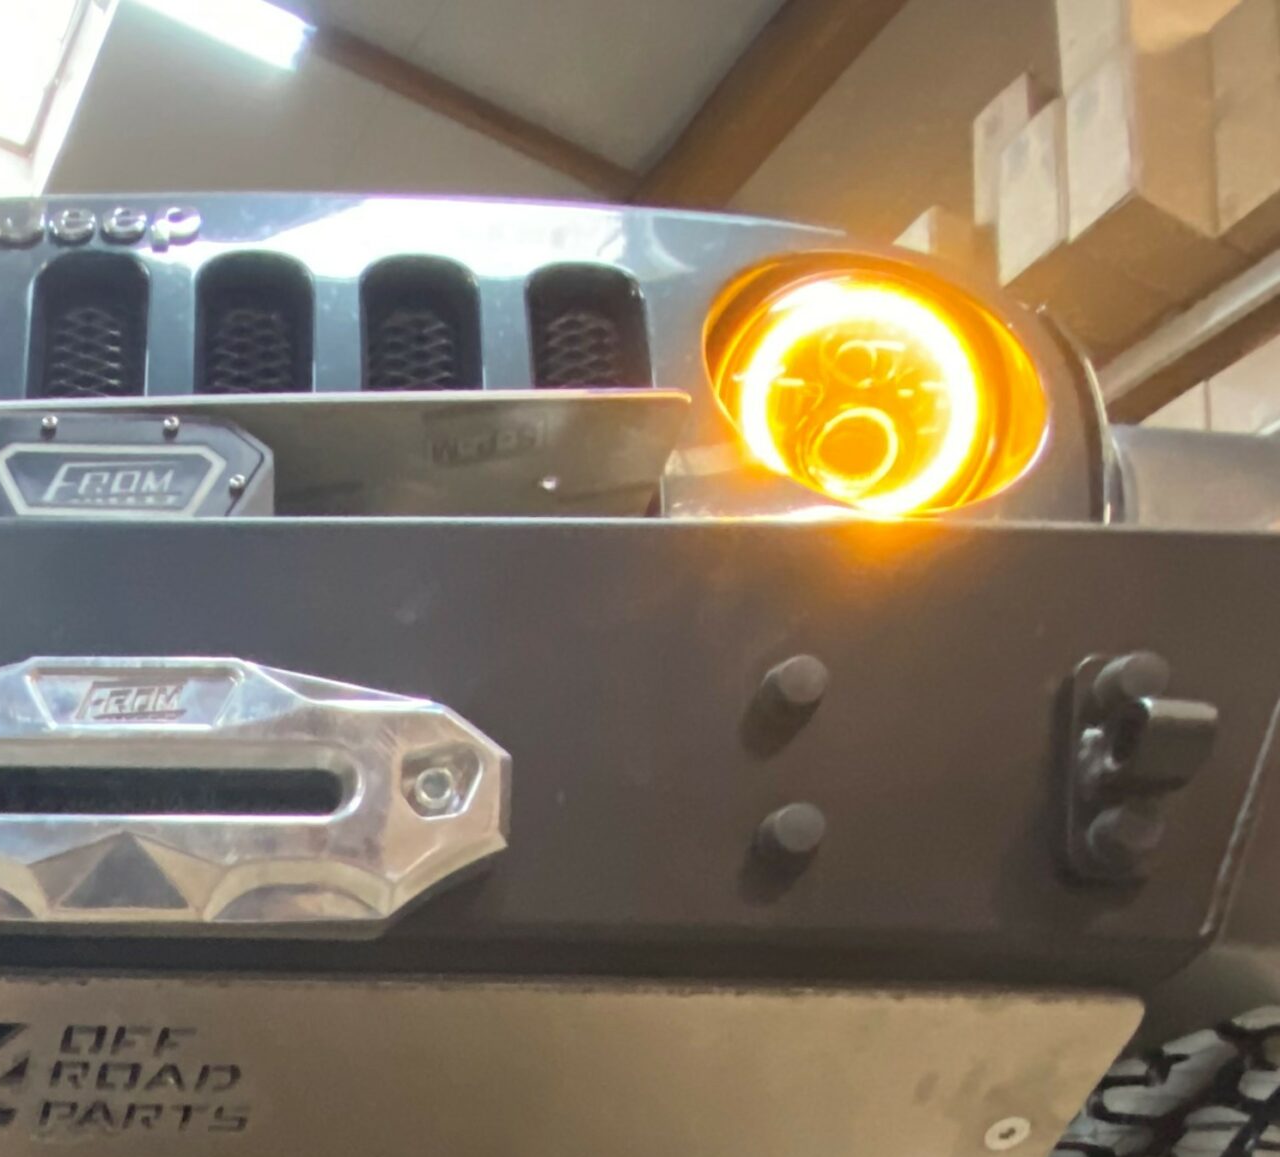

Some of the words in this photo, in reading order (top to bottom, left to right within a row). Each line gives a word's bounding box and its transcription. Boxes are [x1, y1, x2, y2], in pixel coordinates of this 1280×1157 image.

[60, 1024, 198, 1056] OFF
[49, 1060, 241, 1092] ROAD
[37, 1100, 253, 1132] PARTS
